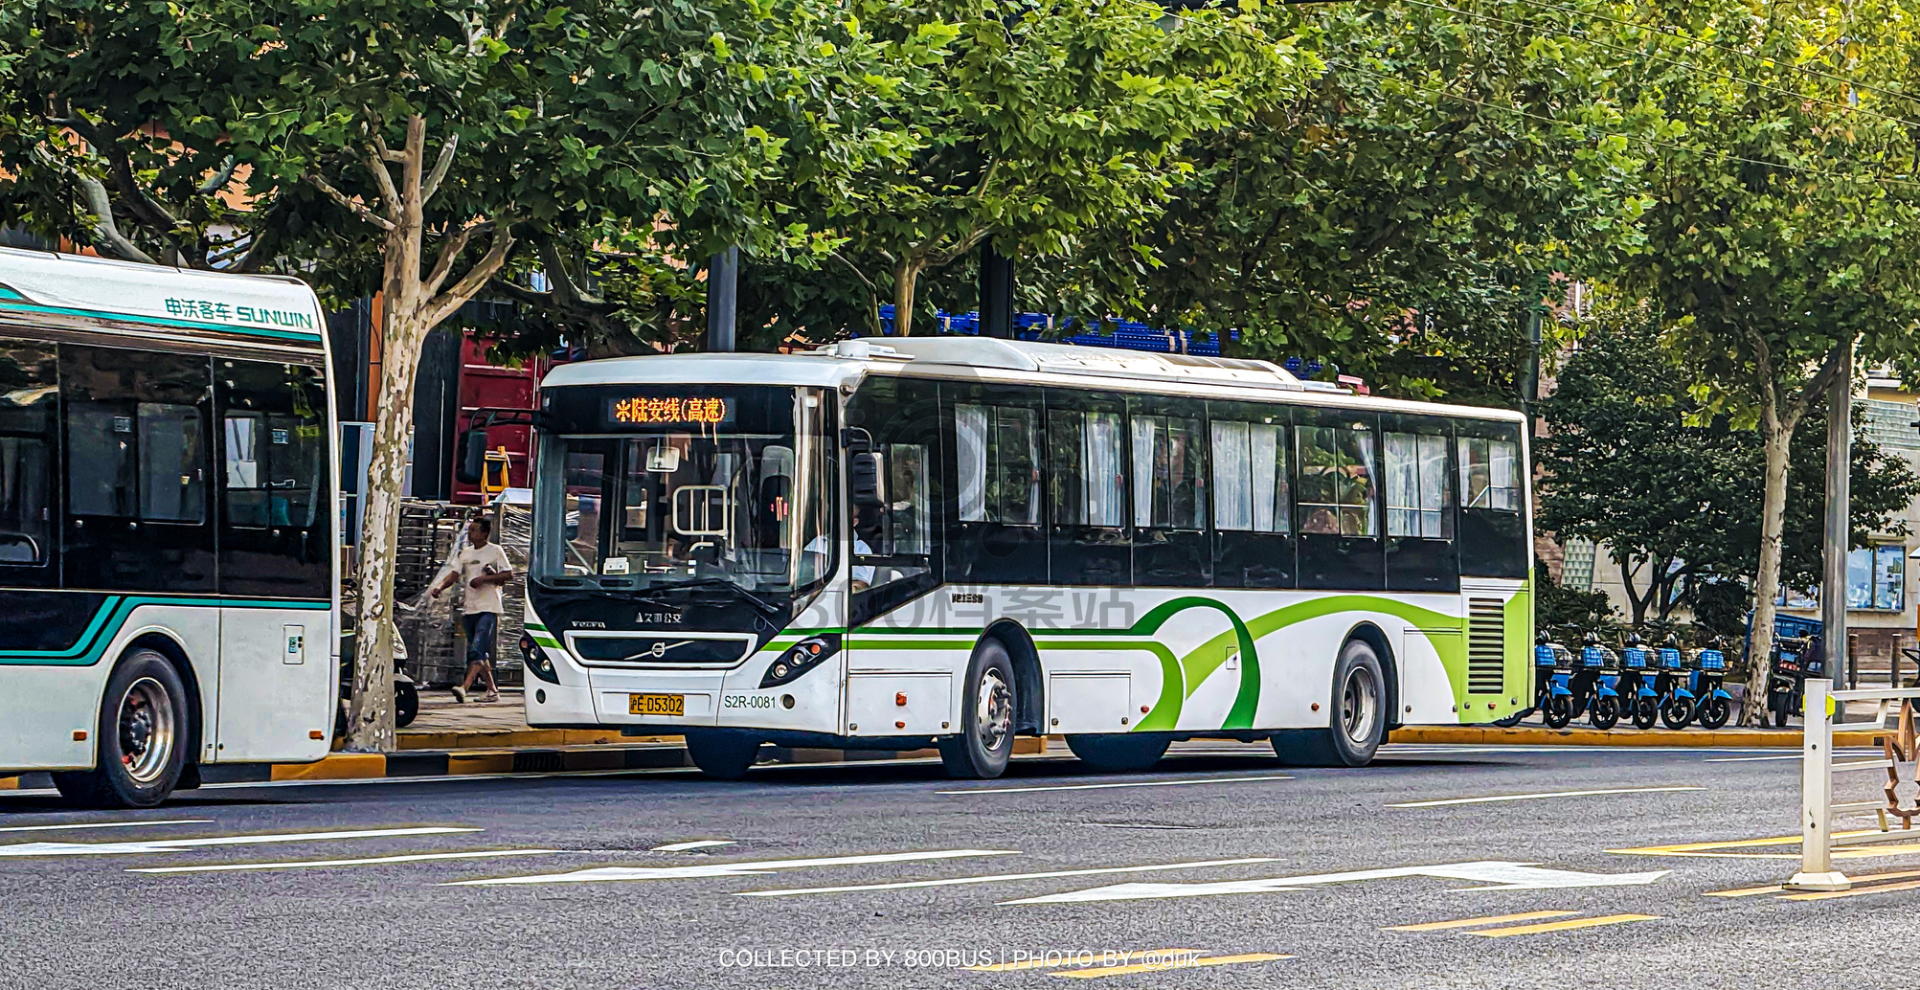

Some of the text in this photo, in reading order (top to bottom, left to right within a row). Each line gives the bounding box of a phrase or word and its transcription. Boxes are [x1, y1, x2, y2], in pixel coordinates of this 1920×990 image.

[165, 297, 312, 328] 申沃客车 SUNWIN
[571, 620, 606, 628] VOLVO
[724, 695, 776, 709] S2R-0081
